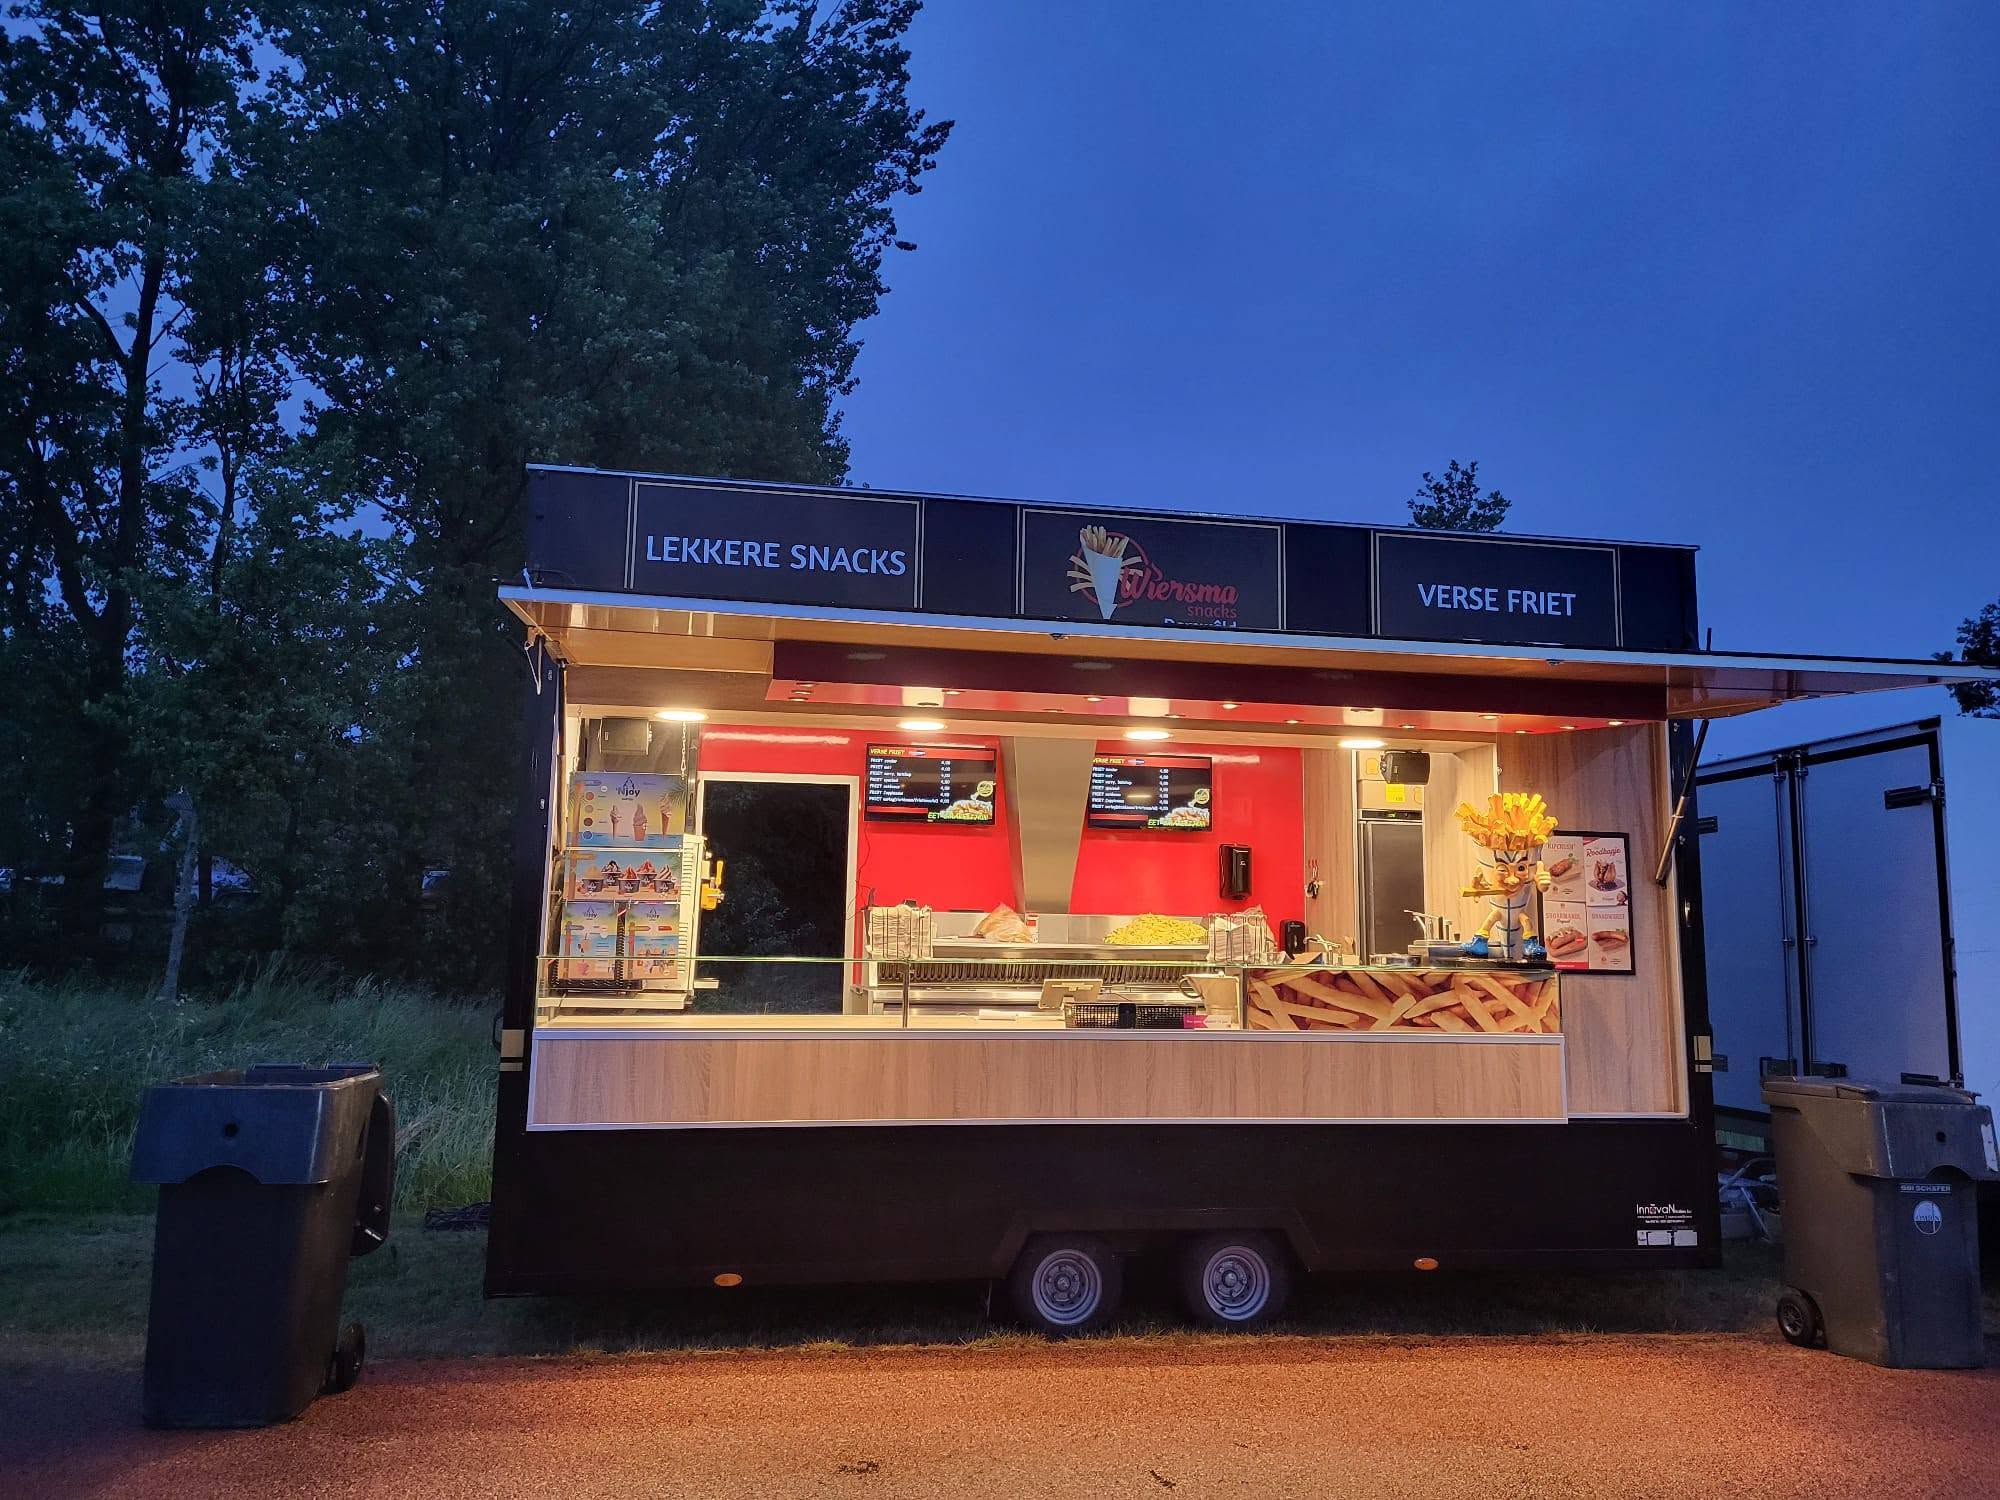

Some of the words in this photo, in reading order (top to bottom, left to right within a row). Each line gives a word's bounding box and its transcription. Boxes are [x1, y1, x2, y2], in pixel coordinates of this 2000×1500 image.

[646, 535, 780, 568] LEKKERE
[790, 544, 906, 576] SNACKS
[1121, 562, 1239, 604] Wiersma
[1417, 583, 1499, 611] VERSE
[1508, 589, 1576, 616] FRIET
[1187, 603, 1237, 618] snacks
